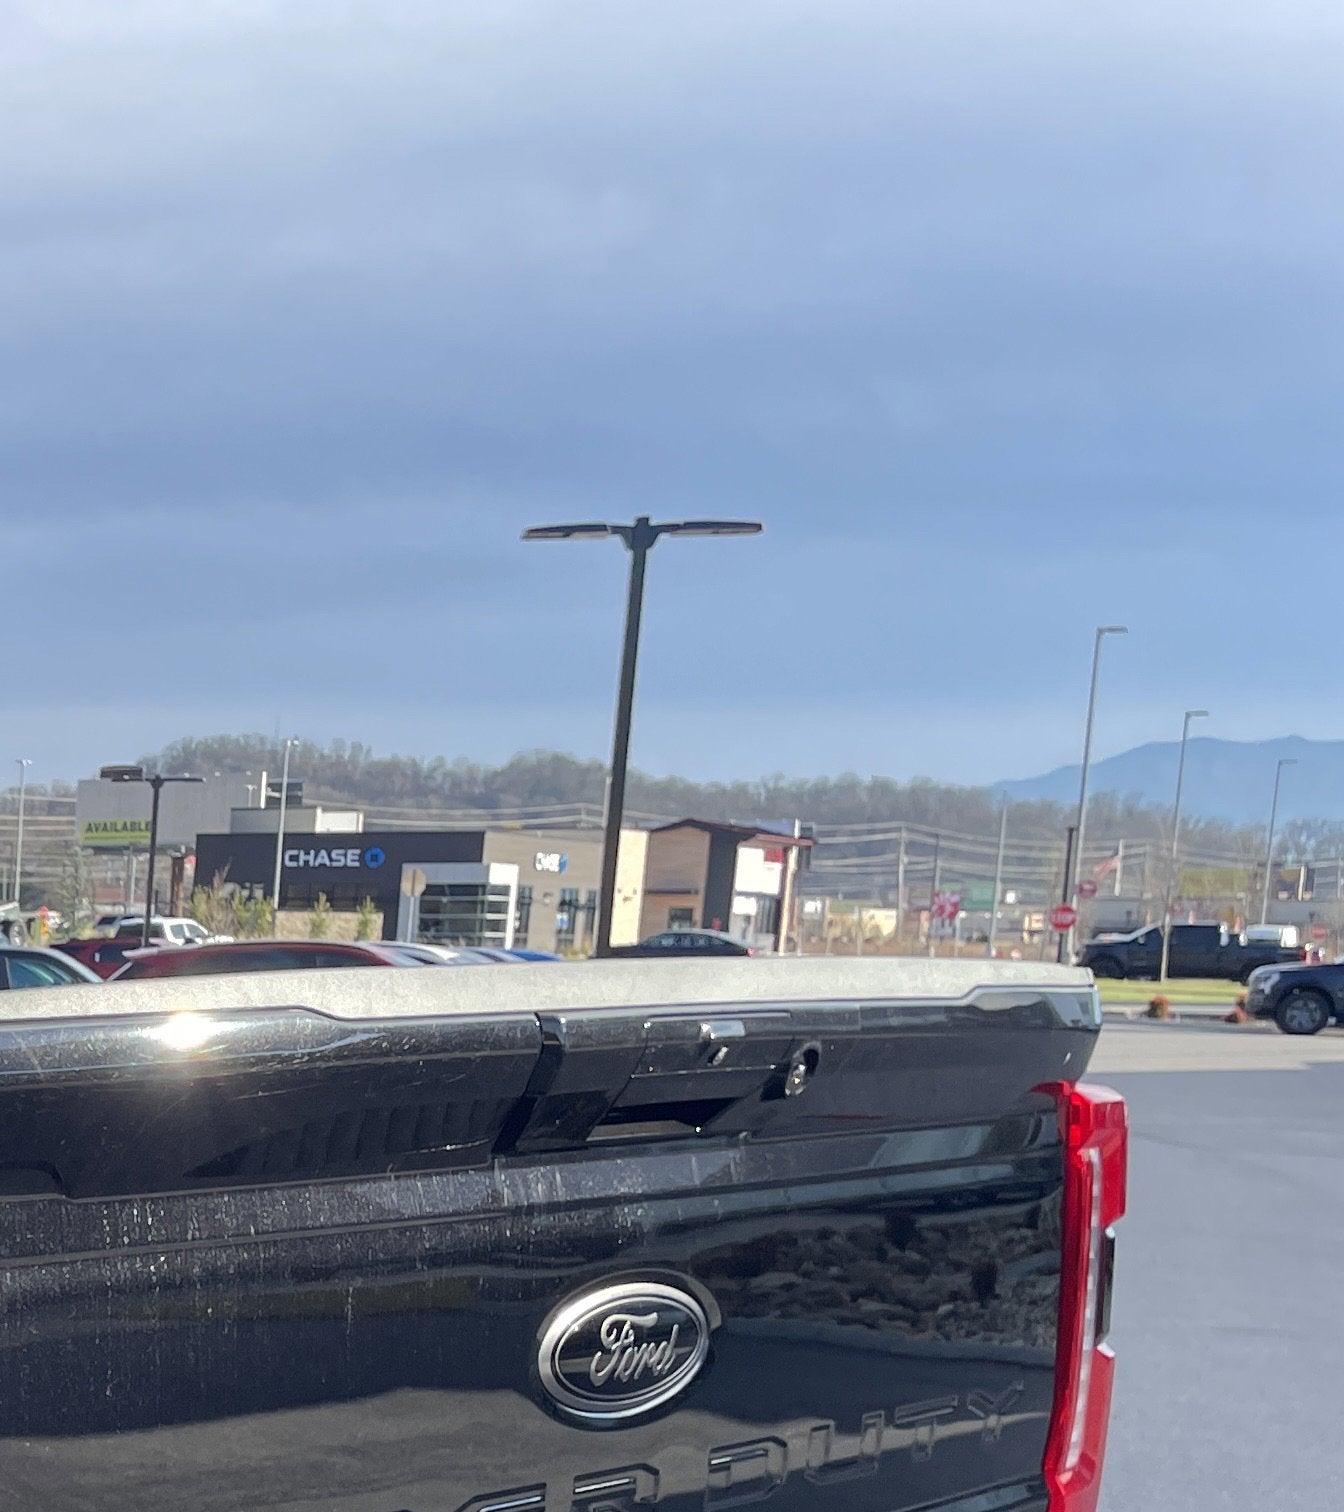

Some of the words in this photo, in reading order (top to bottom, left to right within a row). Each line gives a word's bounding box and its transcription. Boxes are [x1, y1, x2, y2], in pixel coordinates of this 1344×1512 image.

[86, 821, 152, 833] AVAILABLE
[284, 849, 361, 868] CHASE
[589, 1311, 679, 1387] Ford
[704, 1380, 1024, 1512] DUTY
